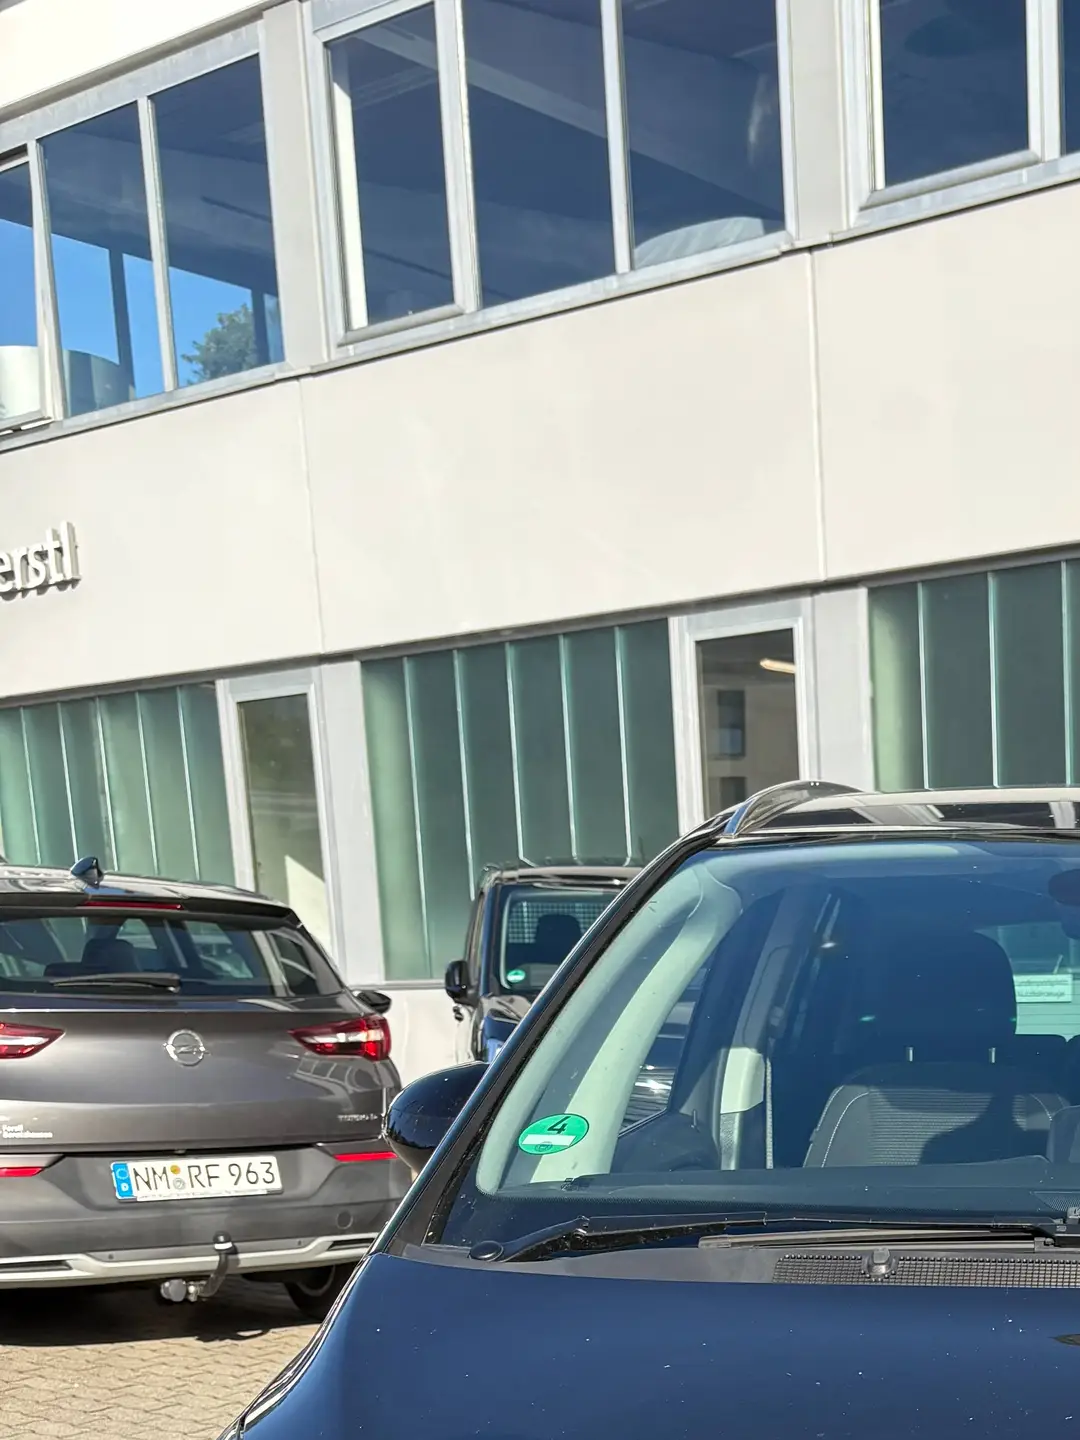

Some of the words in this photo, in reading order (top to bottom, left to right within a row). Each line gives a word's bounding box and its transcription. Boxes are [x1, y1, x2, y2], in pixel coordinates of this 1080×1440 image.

[547, 1115, 571, 1135] 4
[133, 1166, 170, 1191] NM
[187, 1164, 221, 1189] RF
[228, 1161, 276, 1186] 963
